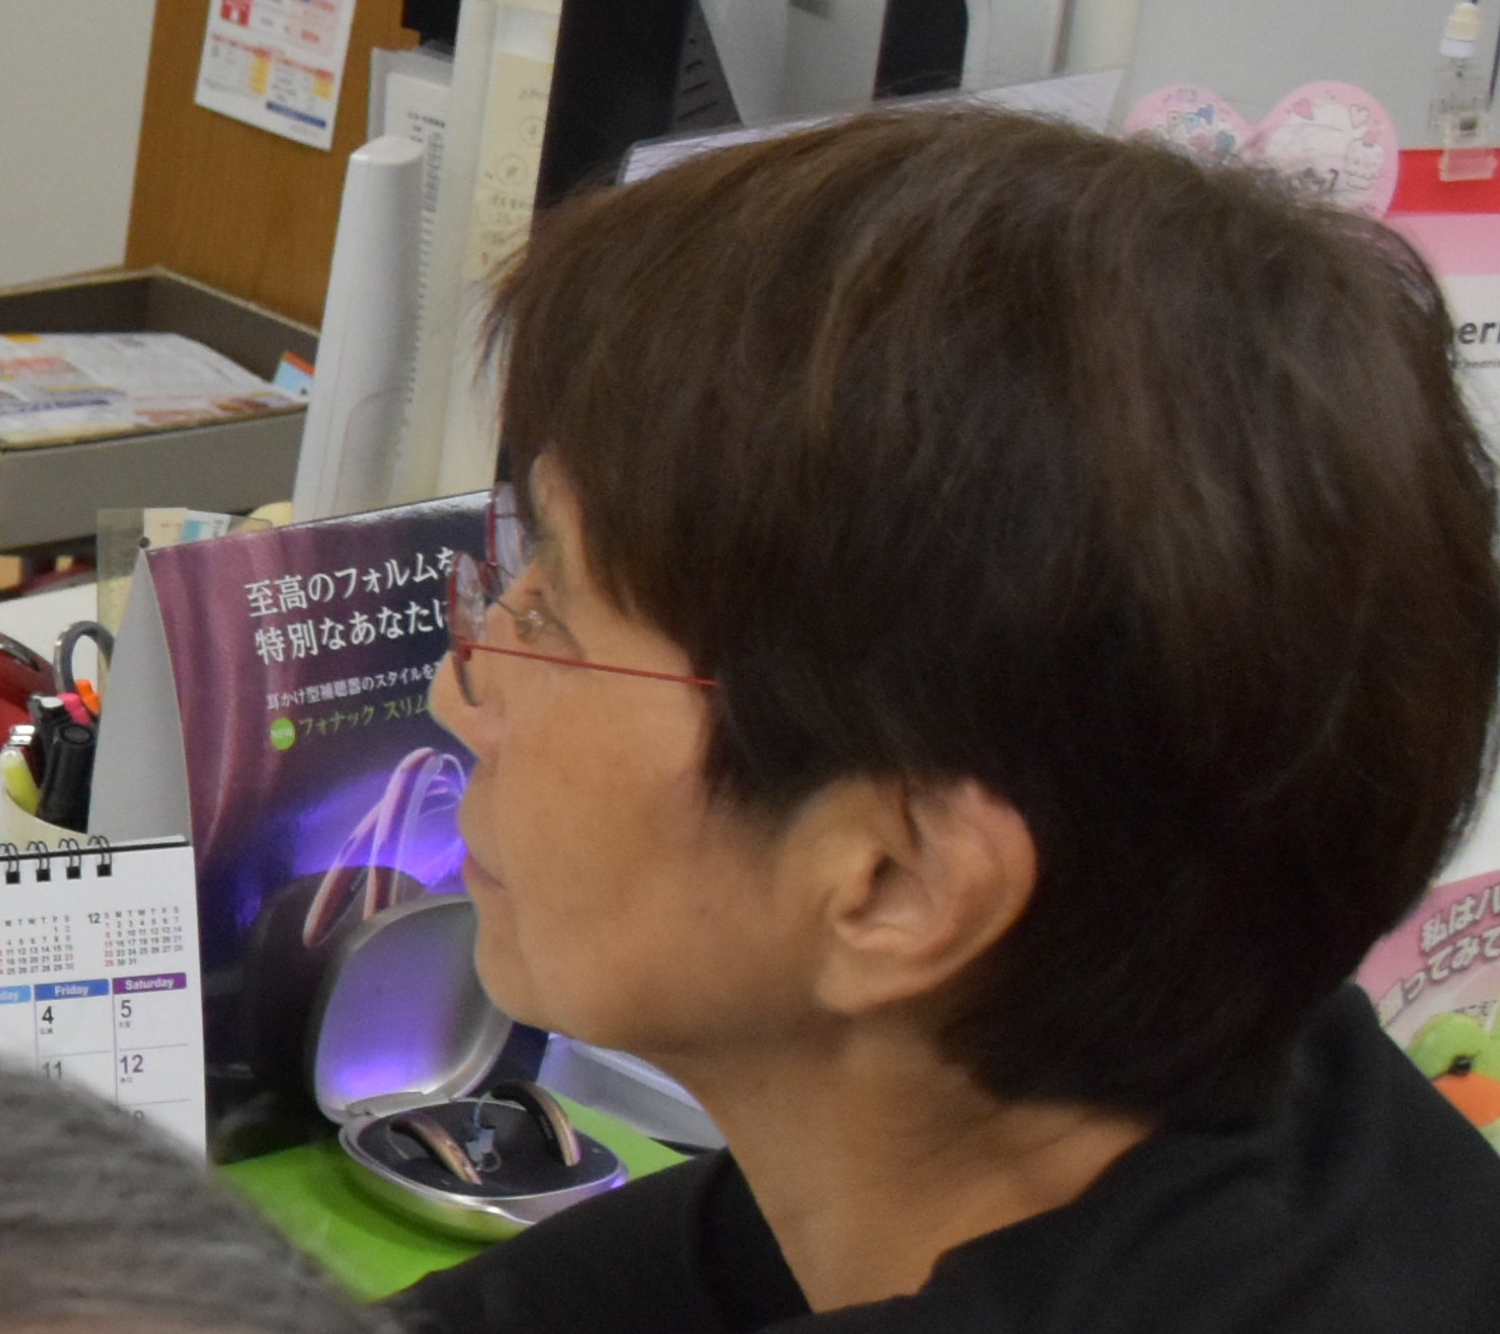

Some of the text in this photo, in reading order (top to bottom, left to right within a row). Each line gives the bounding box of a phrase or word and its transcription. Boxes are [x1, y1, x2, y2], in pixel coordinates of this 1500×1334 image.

[299, 704, 375, 738] フォナック
[88, 913, 100, 924] 12
[54, 984, 89, 998] Friday
[125, 976, 174, 992] Saturday
[42, 1006, 54, 1024] 4
[121, 1000, 132, 1018] 5
[120, 1055, 144, 1074] 12
